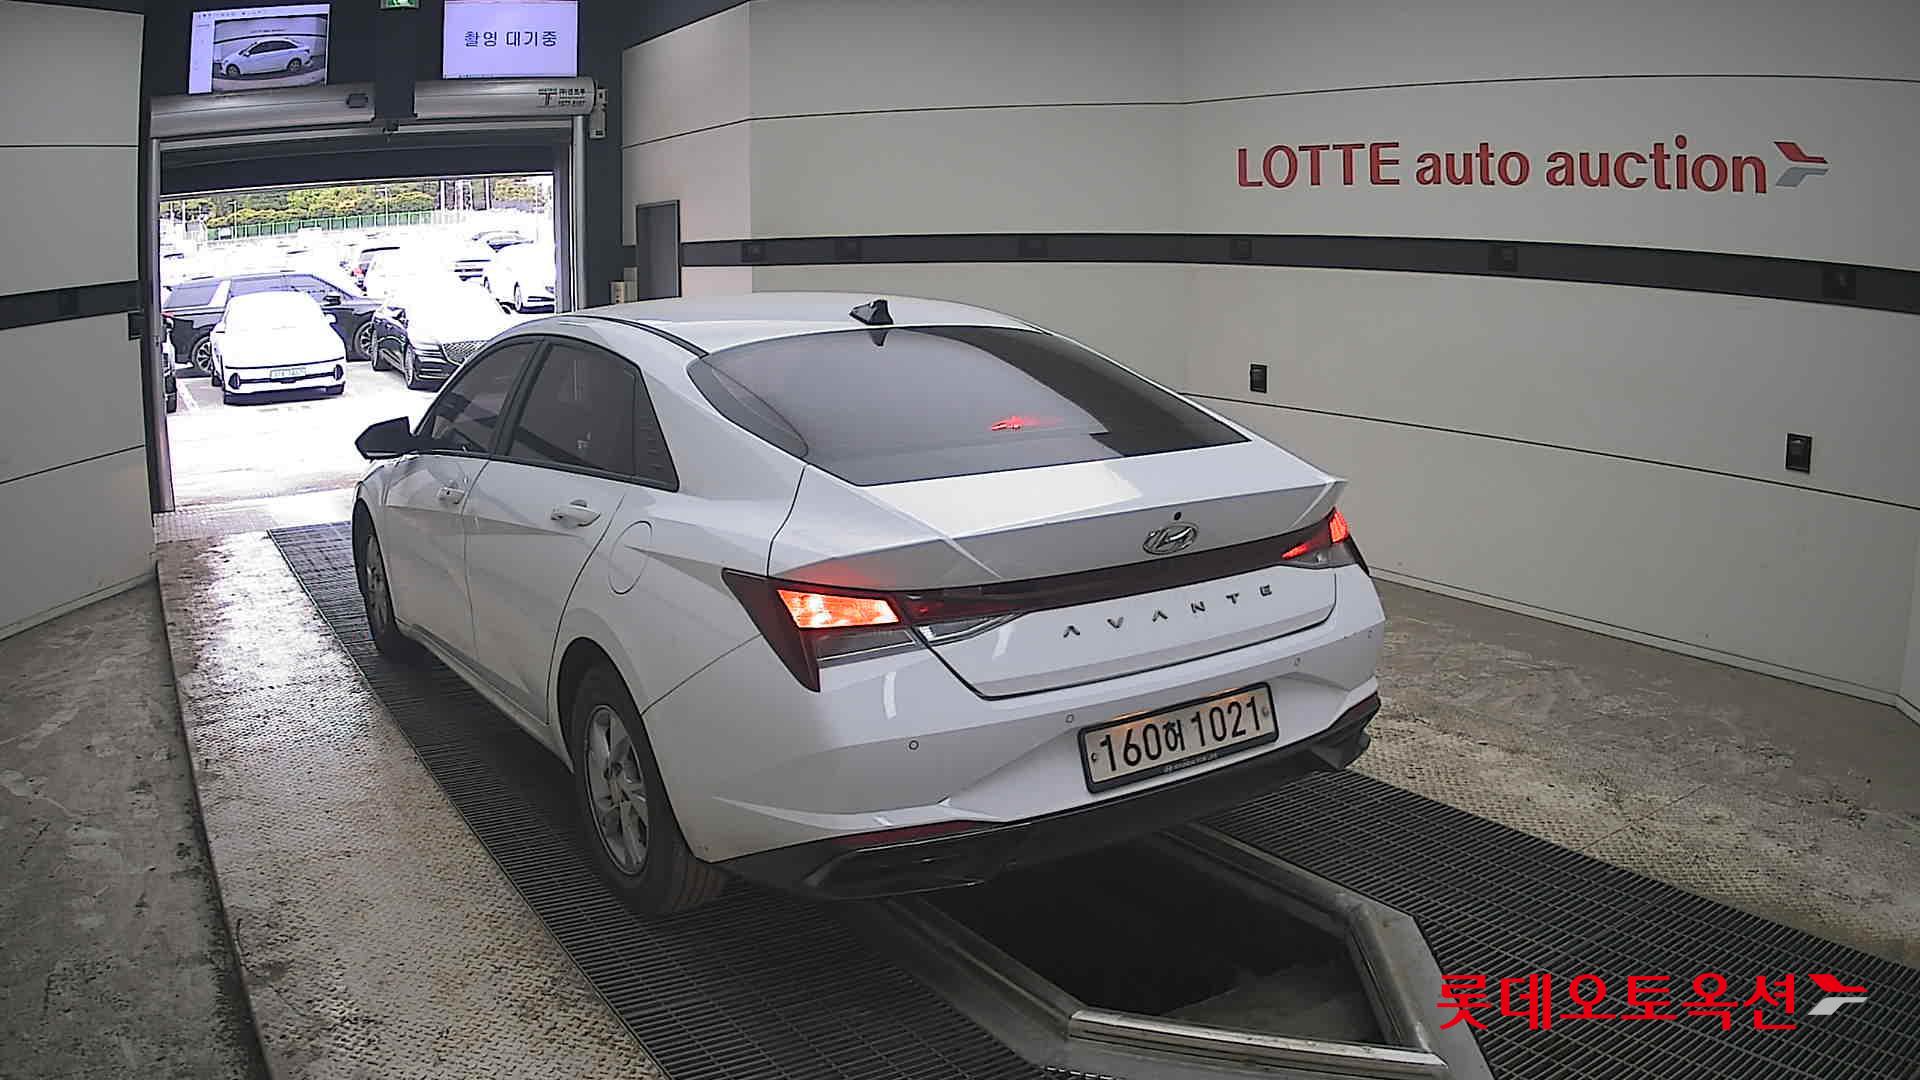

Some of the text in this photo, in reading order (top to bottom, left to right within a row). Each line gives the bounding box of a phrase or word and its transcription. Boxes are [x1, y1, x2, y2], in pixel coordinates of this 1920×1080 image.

[465, 31, 557, 47] 촬영 대기중
[1236, 134, 1767, 194] LOTTE auto auction
[1063, 583, 1272, 638] AVANTE
[1100, 719, 1186, 771] 160허
[1190, 696, 1261, 747] 1021
